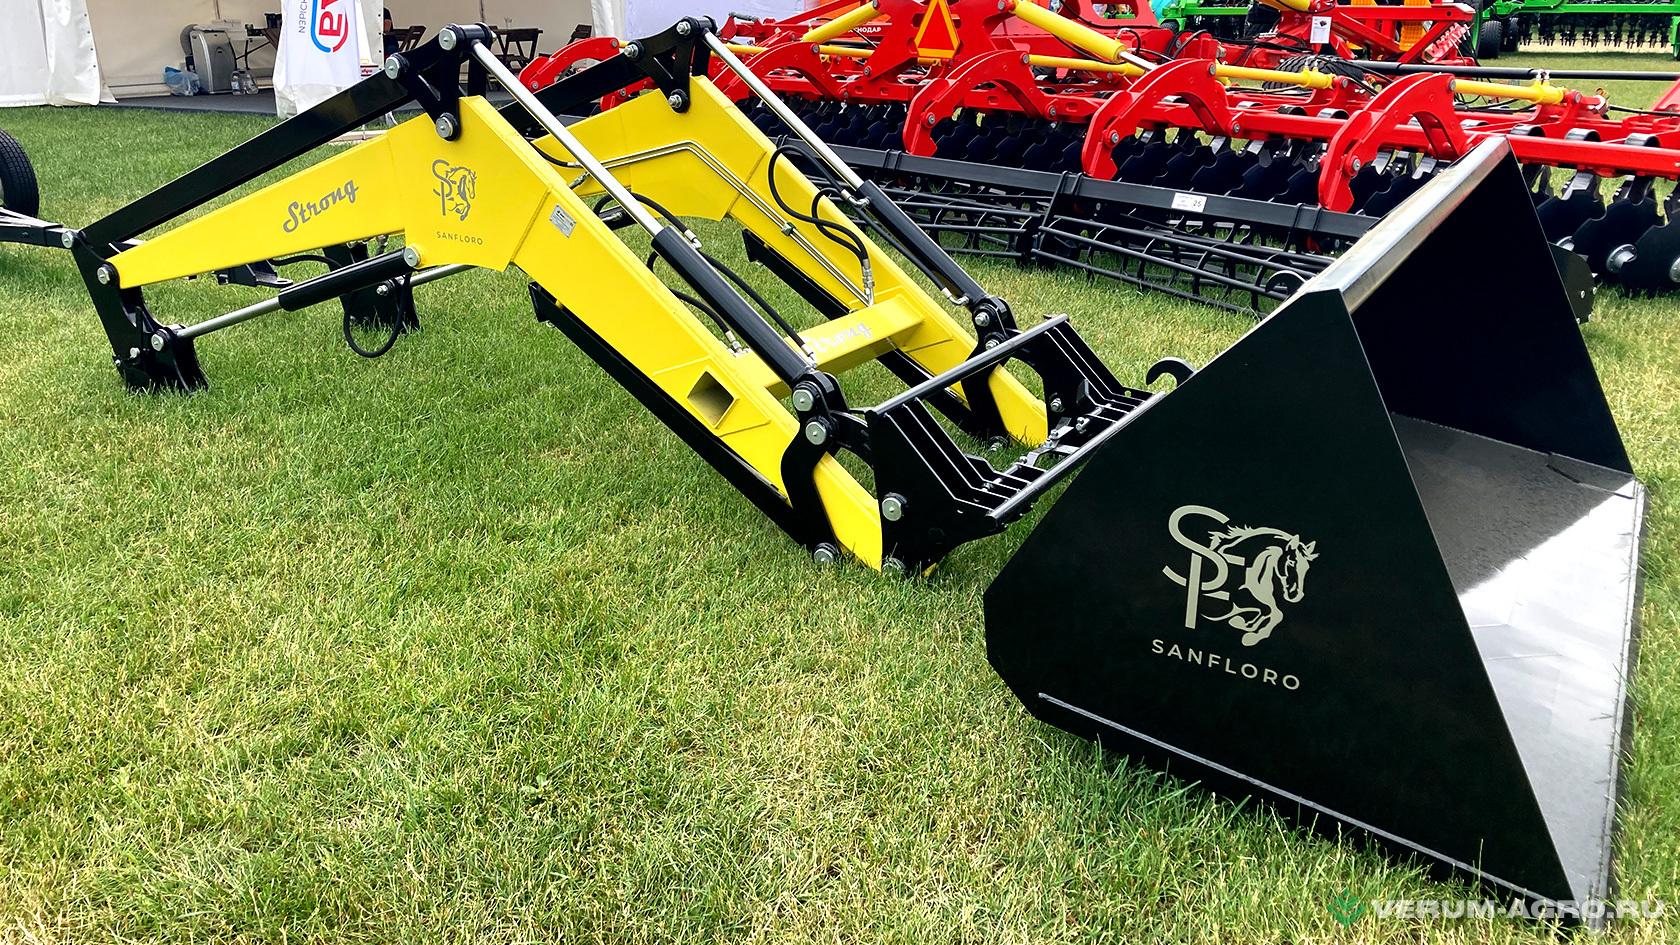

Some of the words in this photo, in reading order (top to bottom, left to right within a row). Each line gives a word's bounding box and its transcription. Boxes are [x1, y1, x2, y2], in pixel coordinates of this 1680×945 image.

[283, 180, 359, 233] Strong
[437, 231, 483, 245] SANFLORO
[1152, 639, 1300, 690] SANFLORO
